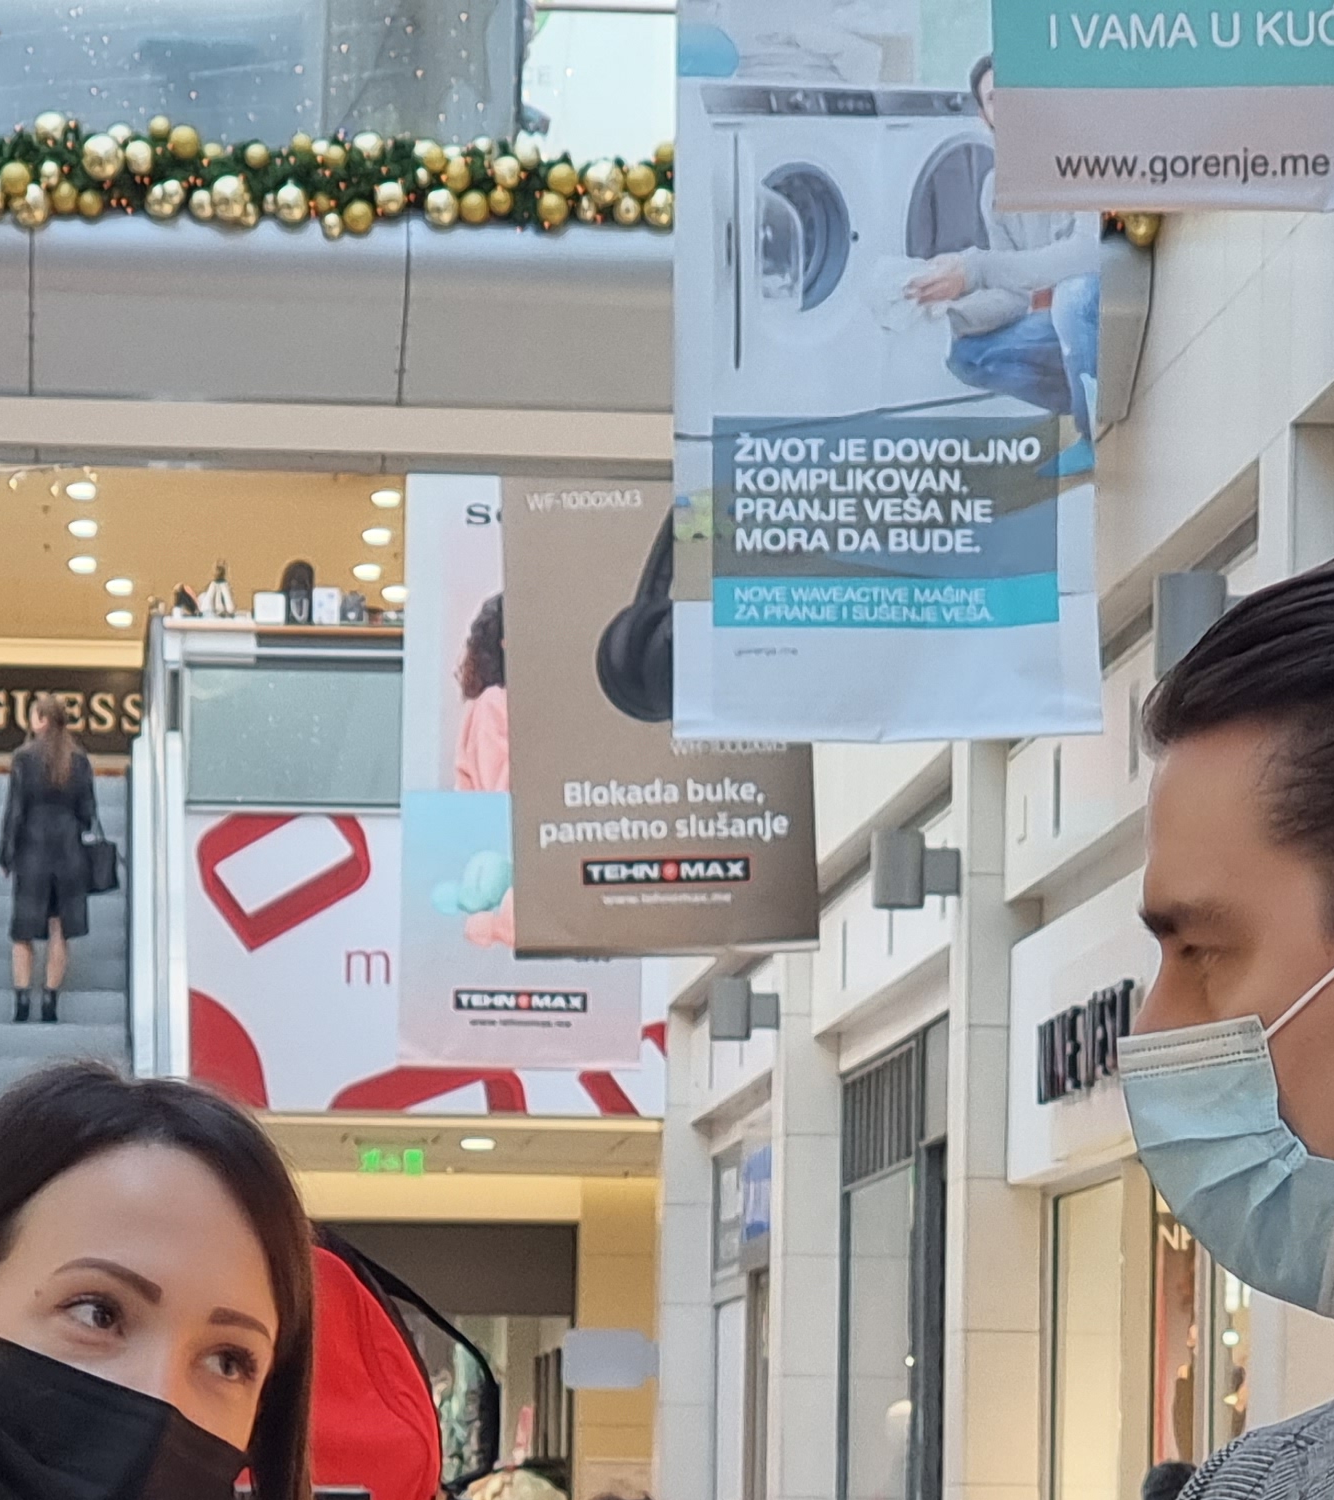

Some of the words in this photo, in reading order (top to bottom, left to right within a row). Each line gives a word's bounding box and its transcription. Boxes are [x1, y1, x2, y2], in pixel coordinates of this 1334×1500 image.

[1049, 14, 1057, 48] I
[1072, 13, 1197, 49] VAMA
[1210, 13, 1241, 48] U
[1054, 148, 1330, 184] www.gorenje.me
[734, 432, 825, 463] ŽIVOT
[830, 438, 866, 463] JE
[873, 437, 1041, 463] DOVOLJNO
[735, 468, 968, 493] KOMPLIKOVAN.
[466, 503, 502, 525] S
[735, 497, 856, 523] PRANJE
[864, 492, 943, 523] VEŠA
[951, 499, 992, 523] NE
[735, 528, 829, 552] MORA
[837, 528, 879, 552] DA
[888, 528, 981, 553] BUDE.
[734, 587, 786, 603] NOVE
[791, 587, 909, 604] WAVEACTIVE
[735, 604, 760, 620] ZA
[766, 604, 839, 621] PRANJE
[842, 605, 848, 620] I
[852, 603, 937, 622] SUŠENJE
[564, 778, 680, 808] Blokada
[687, 777, 765, 806] buke,
[539, 817, 668, 848] pametno
[675, 811, 789, 842] slušanje
